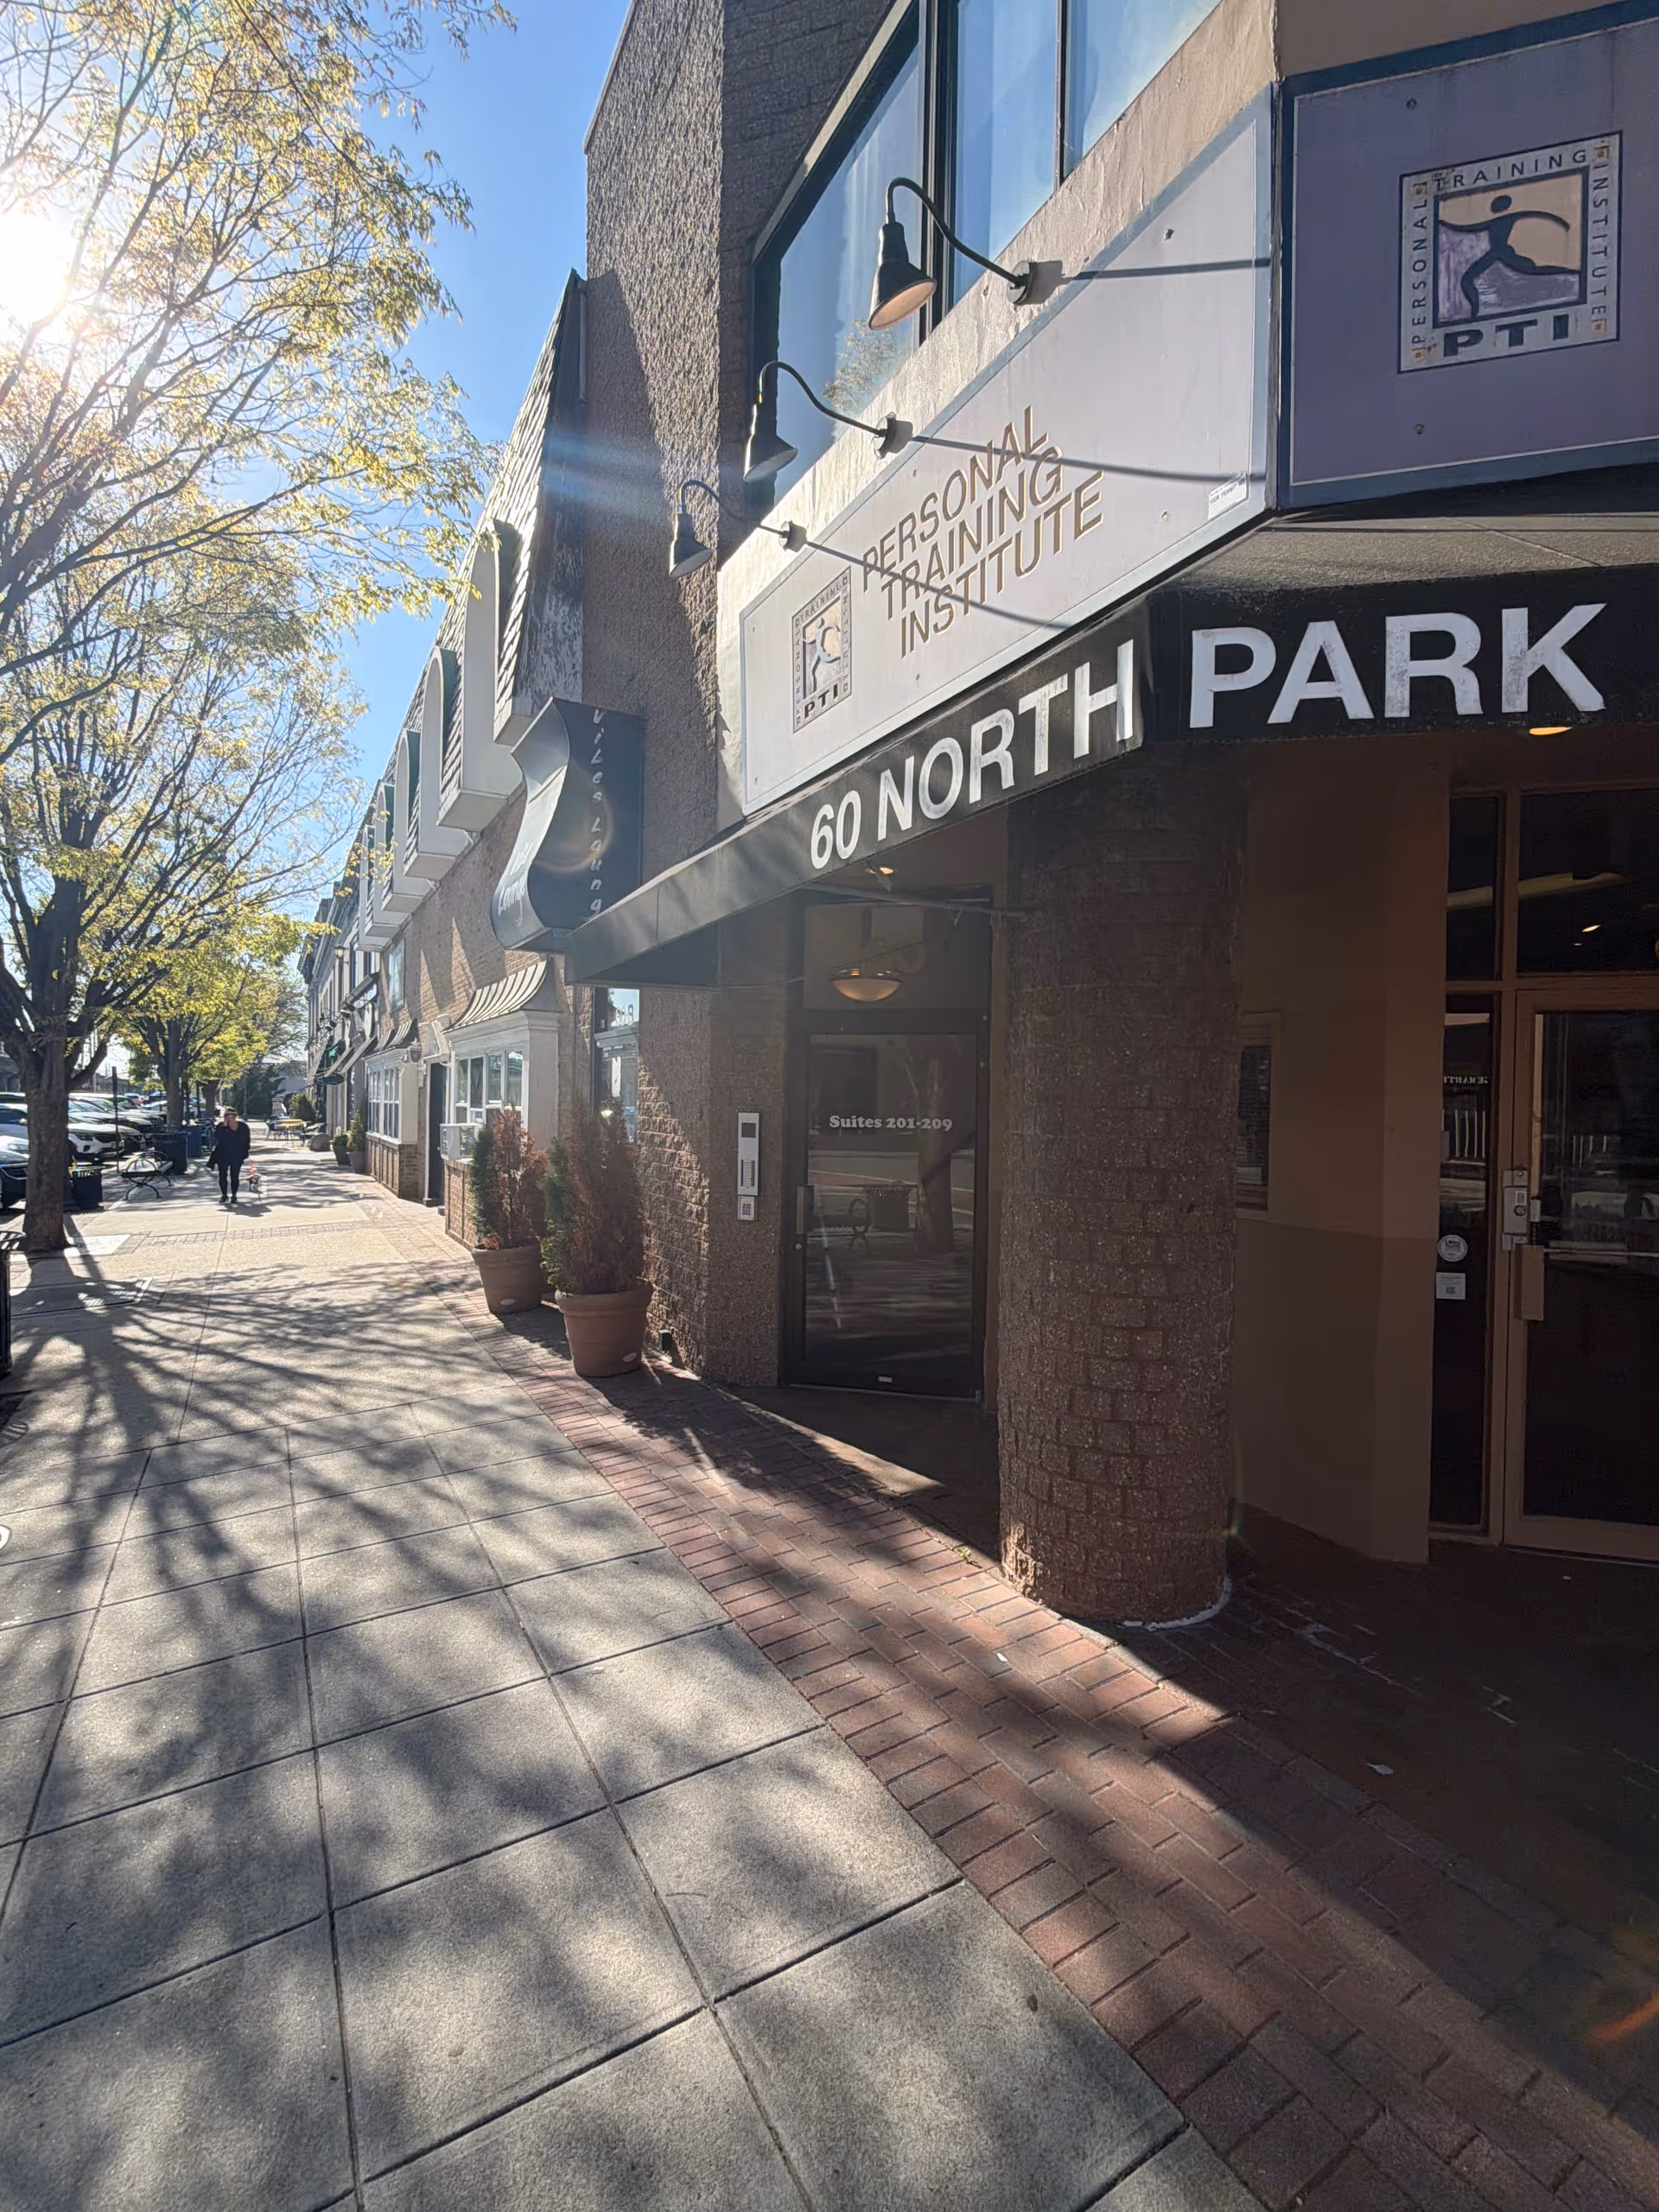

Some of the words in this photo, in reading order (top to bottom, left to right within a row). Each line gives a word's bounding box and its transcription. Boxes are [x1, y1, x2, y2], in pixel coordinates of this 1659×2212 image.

[1433, 149, 1587, 191] TRAINING
[1412, 198, 1427, 346] PERSONAL
[1591, 163, 1610, 315] INSTITUTE
[1443, 313, 1570, 358] PTI
[861, 404, 1050, 594] PERSONAL
[880, 445, 1064, 621] TRAINING
[800, 579, 842, 622] TRAINING
[901, 470, 1105, 659] INSTITUTE
[804, 682, 839, 720] PTI
[810, 790, 862, 870] 60
[877, 638, 1135, 842] NORTH
[1189, 602, 1607, 728] PARK
[588, 817, 602, 920] Loung
[829, 1115, 882, 1128] Suites
[886, 1117, 953, 1132] 201-209
